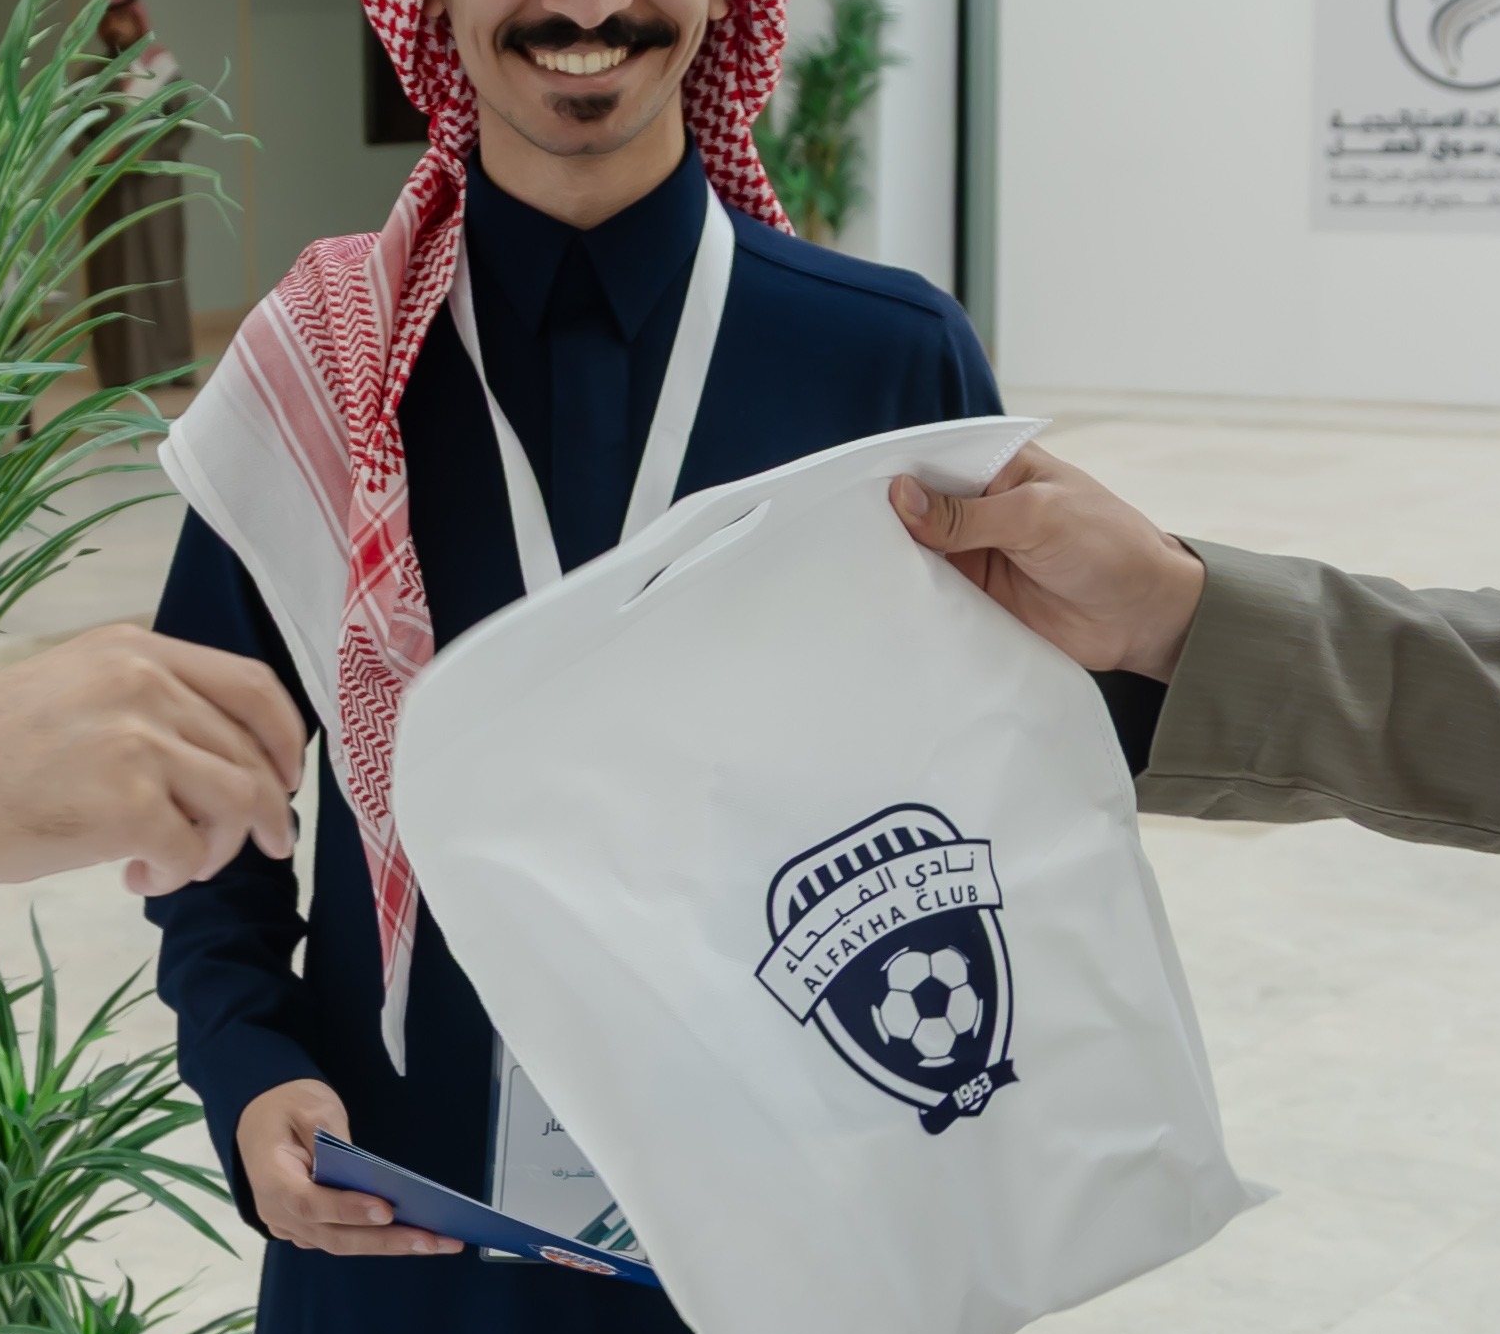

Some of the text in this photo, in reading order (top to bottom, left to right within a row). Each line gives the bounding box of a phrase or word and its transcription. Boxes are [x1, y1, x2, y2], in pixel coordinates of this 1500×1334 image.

[783, 850, 974, 973] نادي الفيحاء
[803, 885, 978, 994] ALFAYHA CLUB
[952, 1071, 993, 1110] 1953
[552, 1167, 596, 1181] مشرف
